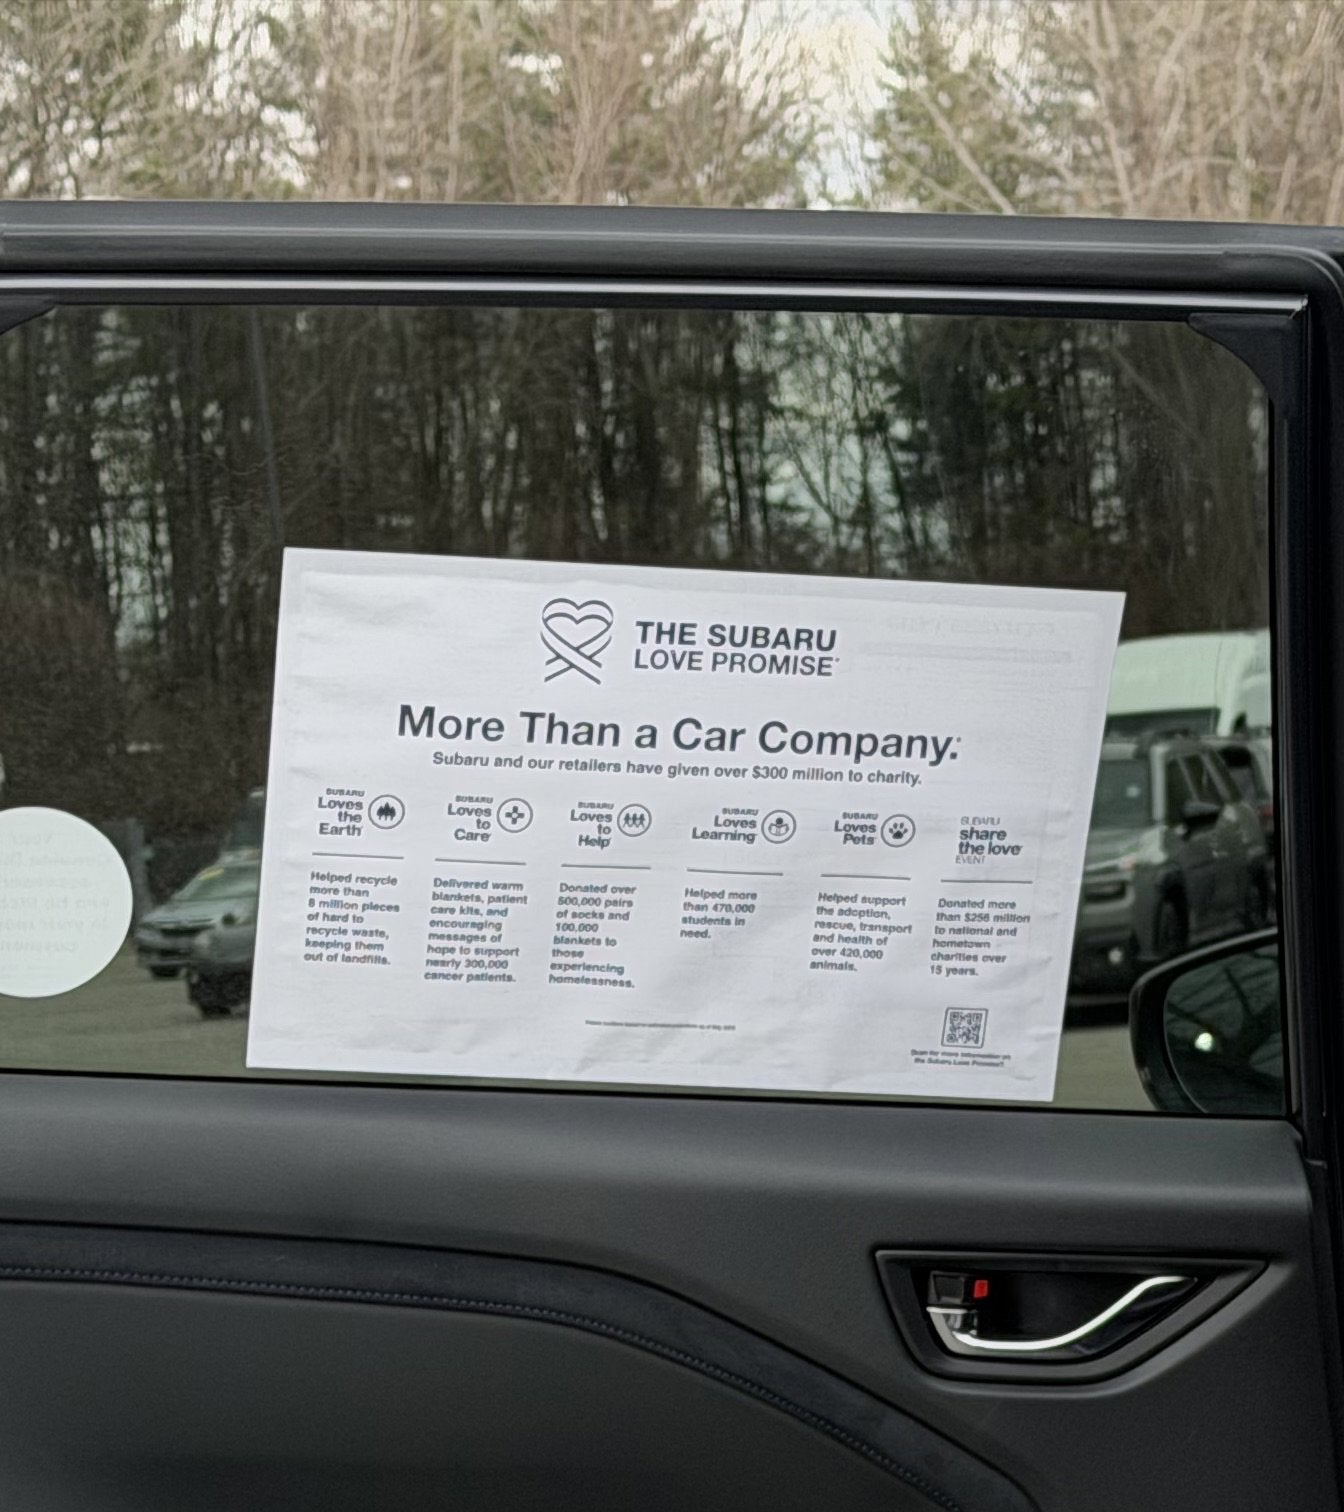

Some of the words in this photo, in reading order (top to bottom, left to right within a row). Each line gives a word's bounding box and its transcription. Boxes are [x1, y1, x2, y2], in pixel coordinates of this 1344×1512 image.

[635, 620, 698, 646] THE
[707, 623, 837, 652] SUBARU
[633, 649, 703, 673] LOVE
[711, 652, 834, 676] PROMISE
[398, 703, 505, 742] More
[519, 710, 621, 748] Than
[634, 720, 657, 750] a
[672, 717, 746, 753] Car
[758, 720, 959, 766] Company.
[432, 751, 490, 768] Subaru
[494, 754, 524, 769] and
[528, 756, 556, 770] our
[558, 757, 623, 774] retailers
[625, 760, 663, 775] have
[666, 762, 711, 779] given
[714, 764, 748, 778] over
[751, 764, 788, 780] $300
[791, 765, 844, 782] million
[847, 768, 864, 783] to
[867, 768, 923, 787] charity.
[326, 787, 365, 797] SUBARU
[317, 796, 364, 810] Loves
[455, 795, 494, 804] SUBARU
[578, 801, 615, 810] SUBARU
[447, 803, 492, 817] Loves
[570, 809, 613, 823] Loves
[722, 808, 759, 816] SUBARU
[842, 811, 879, 820] SUBARU
[337, 811, 363, 823] the
[714, 815, 757, 829] Loves
[318, 822, 362, 837] Earth
[476, 818, 491, 830] to
[597, 823, 611, 835] to
[834, 820, 877, 834] Loves
[454, 828, 491, 842] Care
[691, 827, 757, 844] Learning
[842, 833, 875, 846] Pets
[959, 827, 1007, 841] share
[578, 835, 611, 850] Help
[958, 841, 984, 855] the
[987, 842, 1021, 855] love
[955, 855, 986, 864] EVENT
[310, 871, 352, 884] Helped
[355, 873, 398, 887] recycle
[433, 878, 489, 890] Delivered
[491, 882, 524, 891] warm
[309, 886, 340, 896] more
[343, 886, 369, 898] than
[559, 882, 607, 894] Donated
[610, 885, 637, 894] over
[684, 887, 725, 900] Helped
[727, 890, 758, 900] more
[432, 891, 485, 904] blankets,
[487, 894, 528, 905] patient
[604, 898, 633, 908] pairs
[817, 892, 859, 904] Helped
[861, 894, 907, 907] support
[938, 897, 985, 909] Donated
[988, 900, 1016, 909] more
[318, 899, 358, 910] million
[361, 902, 400, 913] pieces
[430, 906, 456, 915] care
[486, 907, 509, 917] and
[683, 901, 708, 912] than
[816, 906, 834, 916] the
[306, 912, 320, 921] of
[322, 912, 349, 923] hard
[352, 913, 364, 924] to
[556, 910, 568, 919] of
[571, 910, 605, 920] socks
[608, 911, 630, 921] and
[681, 915, 731, 926] students
[734, 917, 745, 926] in
[936, 912, 961, 923] than
[993, 913, 1031, 923] million
[429, 919, 502, 931] encouraging
[556, 923, 598, 933] 100,000
[814, 919, 857, 931] rescue,
[859, 922, 913, 934] transport
[934, 925, 945, 935] to
[948, 925, 993, 936] national
[996, 926, 1017, 936] and
[306, 925, 348, 937] recycle
[352, 929, 390, 940] waste,
[428, 932, 487, 944] messages
[490, 933, 502, 943] of
[679, 929, 711, 939] need.
[304, 938, 351, 950] keeping
[354, 940, 384, 951] them
[553, 935, 602, 946] blankets
[605, 937, 617, 947] to
[812, 933, 834, 943] and
[837, 934, 873, 945] health
[876, 935, 888, 946] of
[932, 938, 991, 949] hometown
[426, 944, 456, 957] hope
[459, 945, 471, 955] to
[474, 947, 520, 957] support
[552, 948, 584, 958] those
[811, 947, 837, 957] over
[839, 947, 884, 960] 420,000
[304, 952, 323, 961] out
[326, 952, 339, 962] of
[930, 951, 978, 963] charities
[982, 953, 1007, 963] over
[425, 958, 461, 970] nearly
[464, 959, 509, 970] 300,000
[549, 962, 625, 976] experiencing
[809, 960, 858, 972] animals.
[423, 972, 463, 981] cancer
[466, 971, 517, 983] patients.
[930, 965, 942, 975] 15
[945, 966, 979, 977] years.
[548, 974, 635, 988] homelessness.
